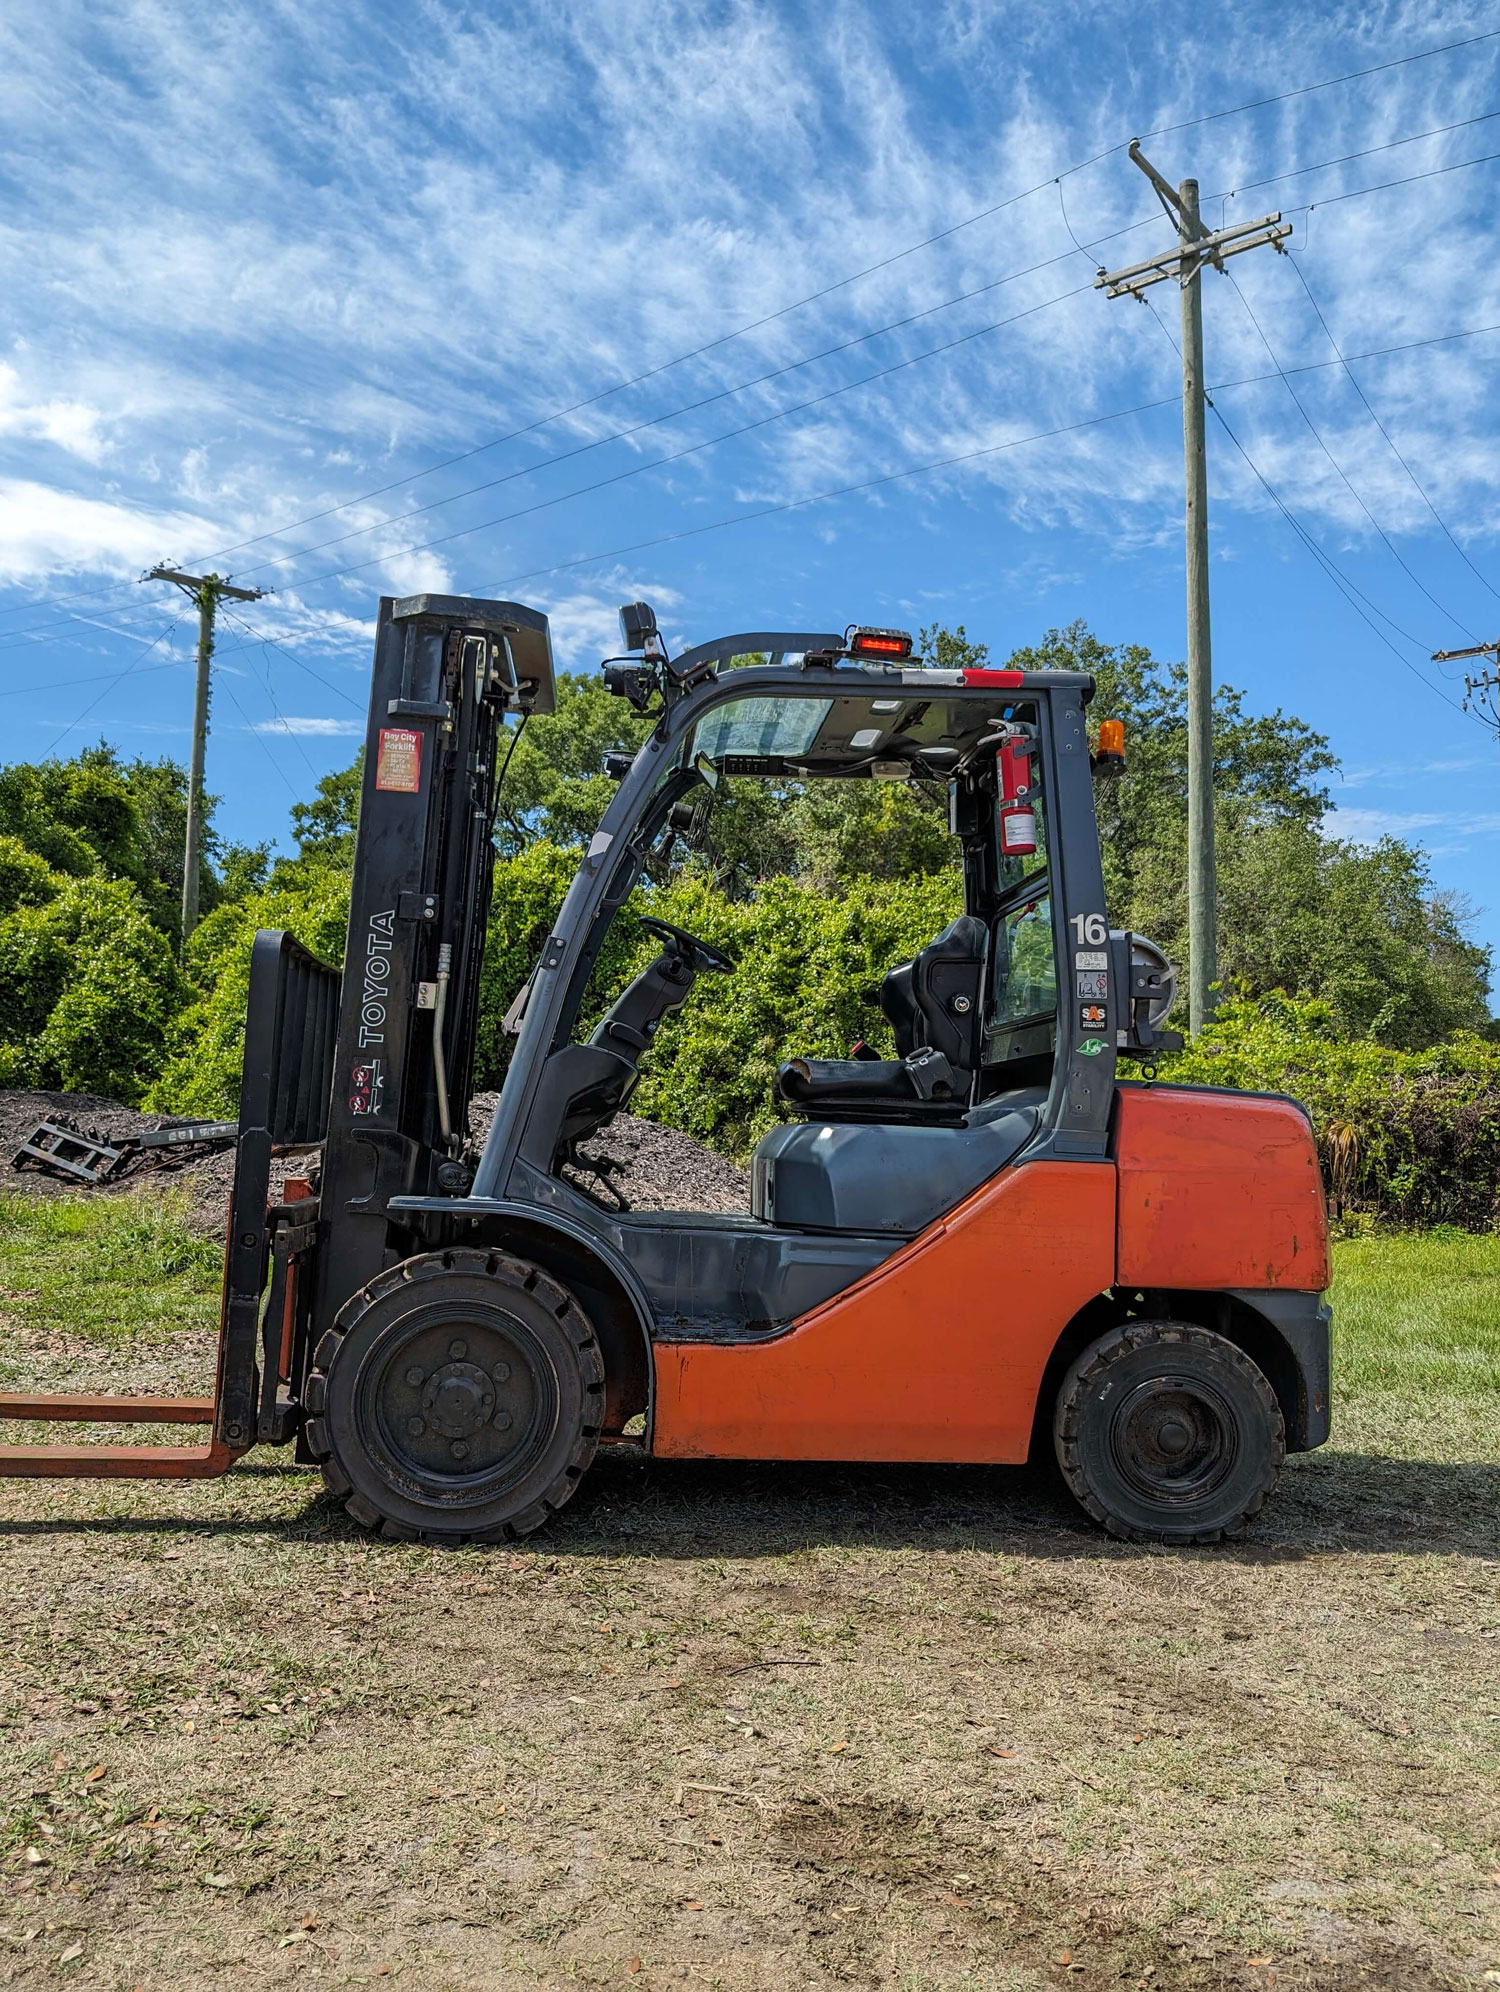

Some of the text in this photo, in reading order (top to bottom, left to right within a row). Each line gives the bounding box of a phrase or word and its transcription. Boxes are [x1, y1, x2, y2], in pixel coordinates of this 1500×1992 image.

[384, 732, 417, 743] Bay City
[385, 742, 416, 751] Forklift
[1070, 913, 1106, 946] 16
[359, 909, 396, 1049] TOYOTA
[1082, 1005, 1106, 1021] SAS
